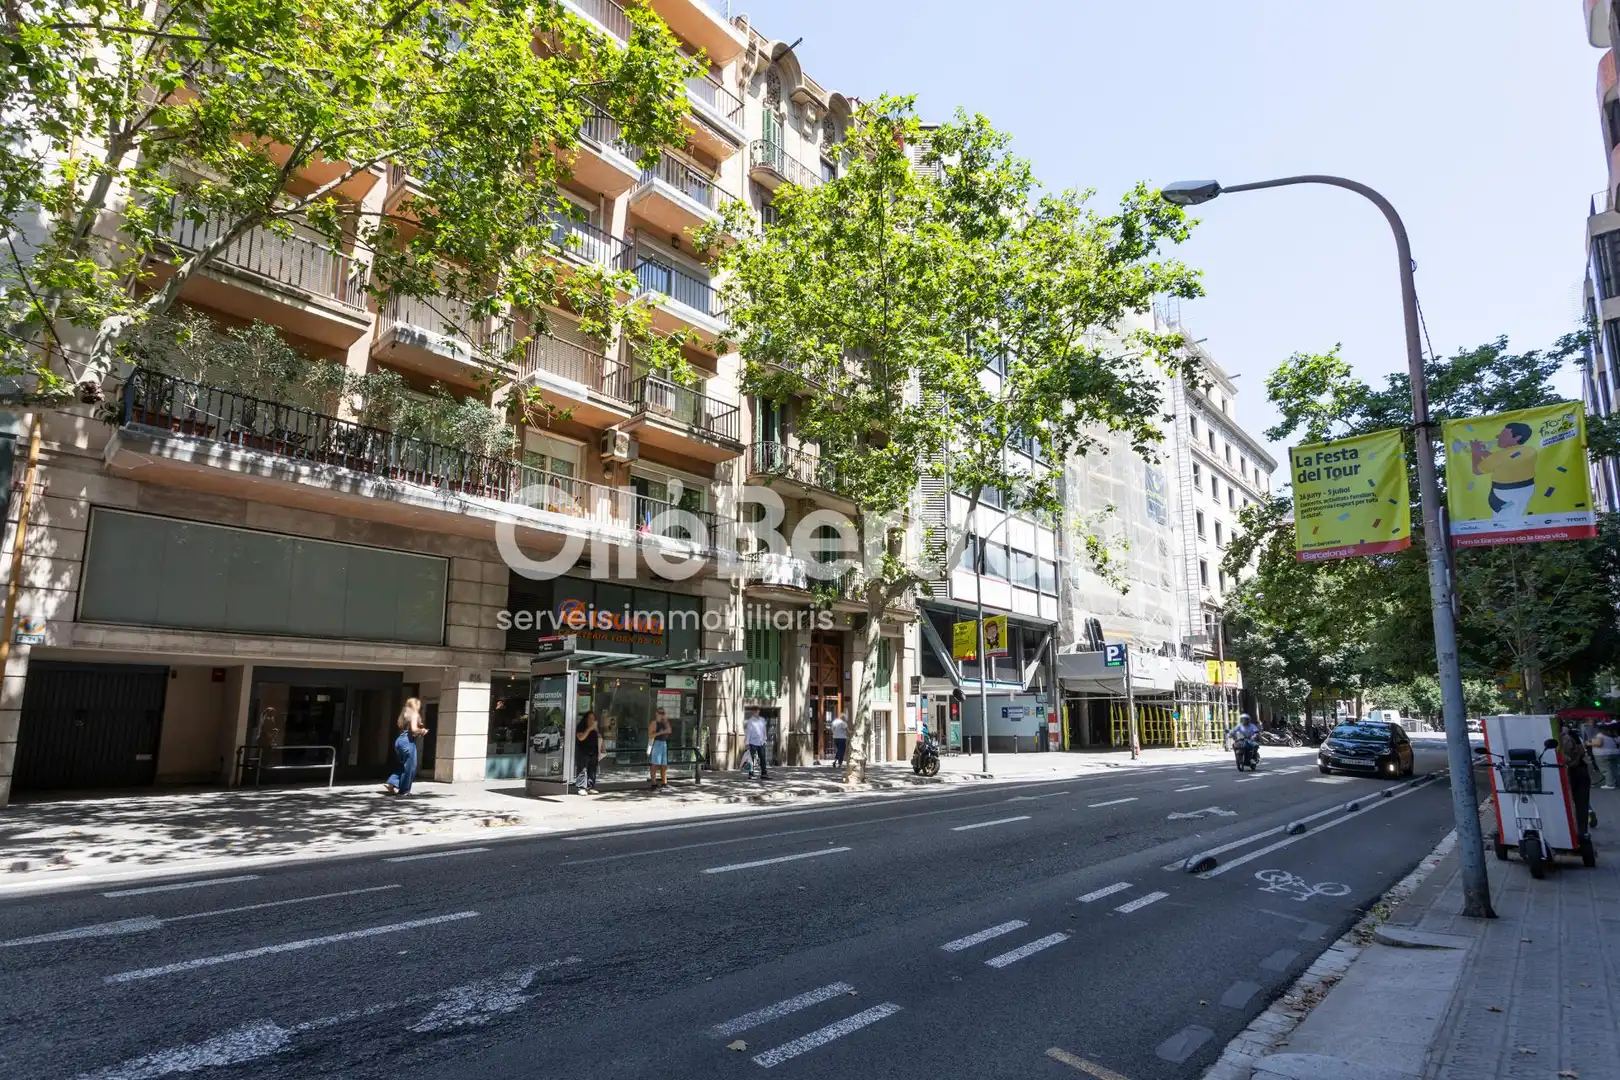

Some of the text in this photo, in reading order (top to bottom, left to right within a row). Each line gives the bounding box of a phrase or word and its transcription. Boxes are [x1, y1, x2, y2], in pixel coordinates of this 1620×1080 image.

[1296, 448, 1358, 468] La Festa
[1298, 464, 1361, 484] del Tour
[1302, 548, 1347, 560] Barcelona
[1106, 646, 1119, 662] P
